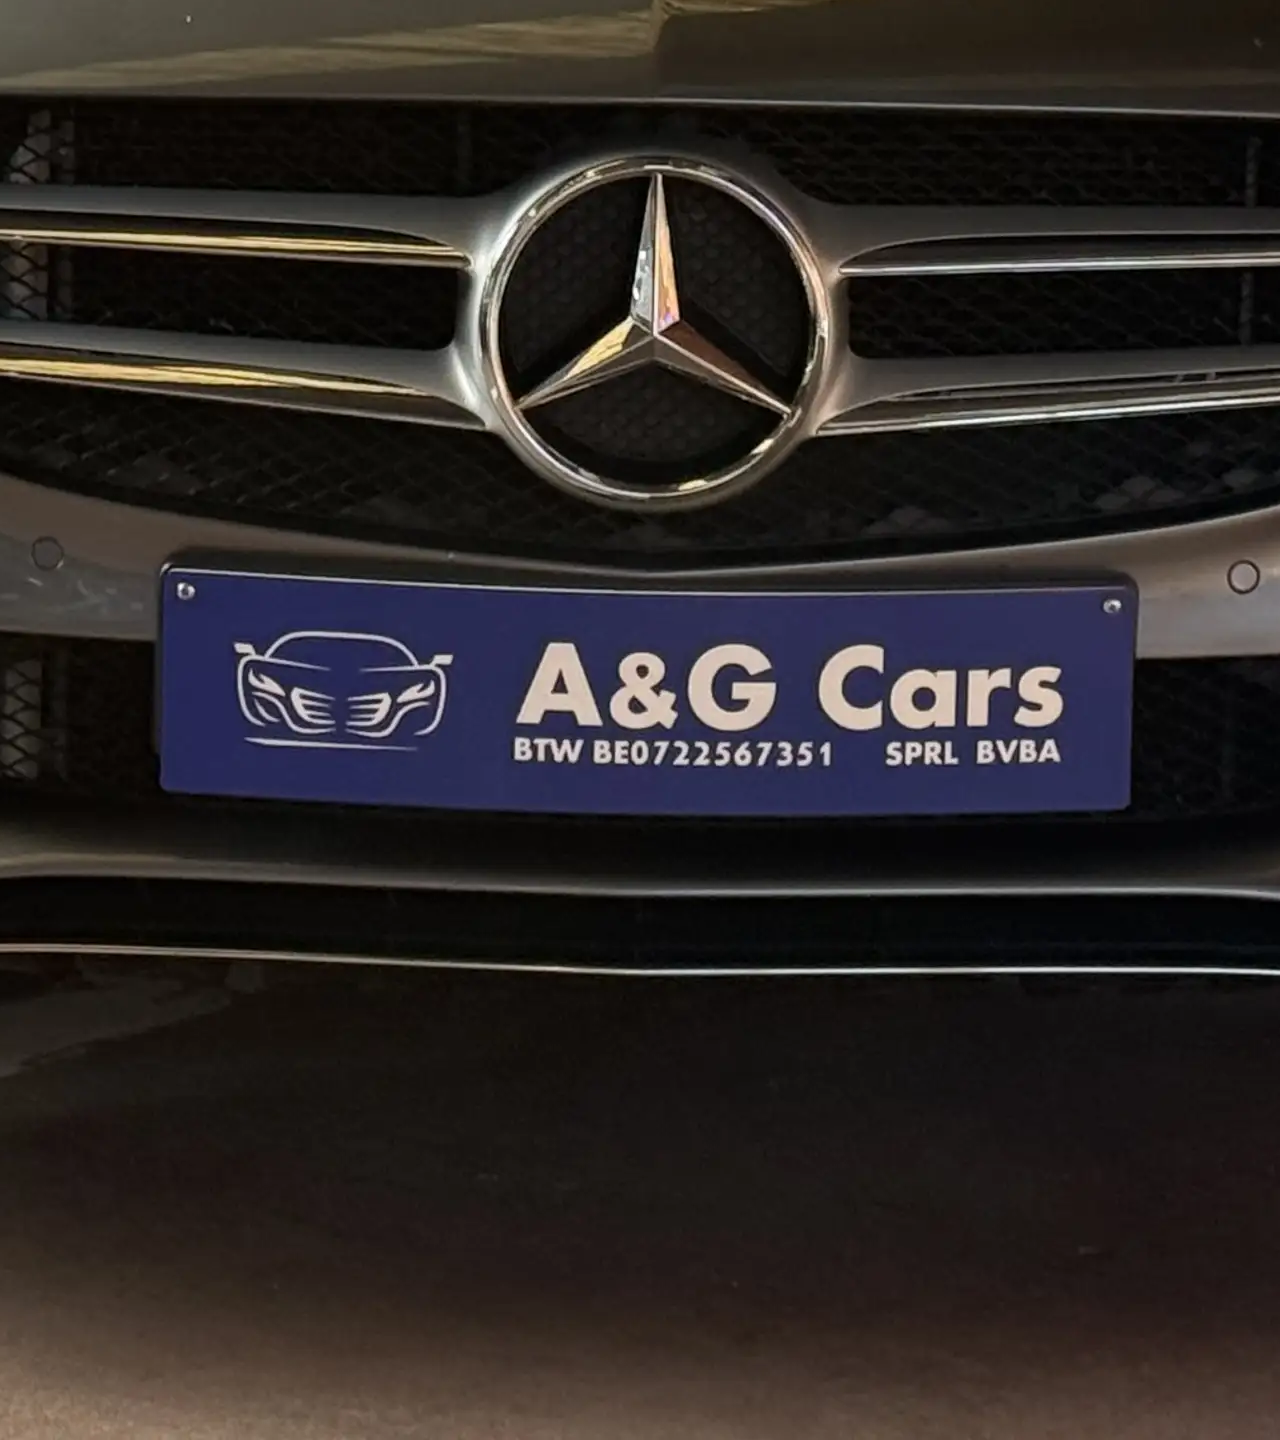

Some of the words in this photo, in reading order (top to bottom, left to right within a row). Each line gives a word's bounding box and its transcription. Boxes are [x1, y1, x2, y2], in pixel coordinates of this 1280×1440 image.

[516, 642, 777, 731] A&G
[819, 644, 1064, 730] Cars
[514, 737, 584, 764] BTW
[593, 740, 832, 767] BE0722567351
[885, 740, 959, 766] SPRL
[976, 738, 1062, 764] BVBA
